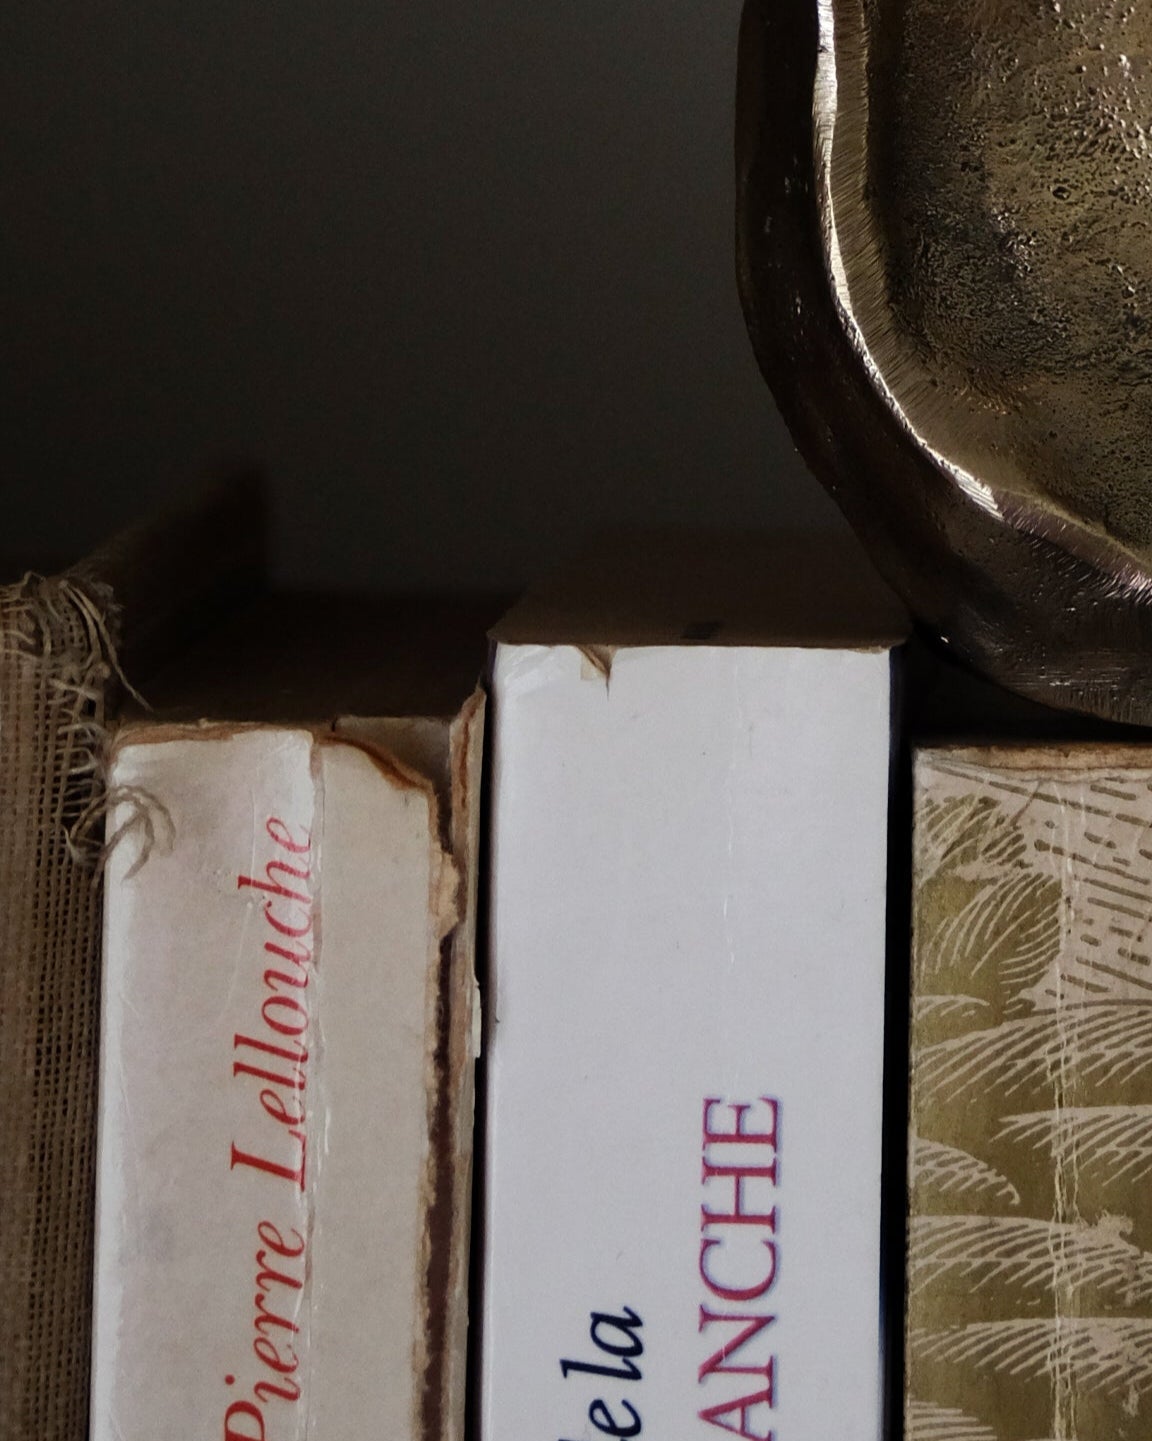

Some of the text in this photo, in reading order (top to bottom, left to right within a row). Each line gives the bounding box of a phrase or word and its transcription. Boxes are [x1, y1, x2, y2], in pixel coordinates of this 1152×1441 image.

[222, 816, 312, 1441] Pierre Lellouche
[697, 1097, 782, 1441] ANCHE
[557, 1306, 643, 1441] e la
